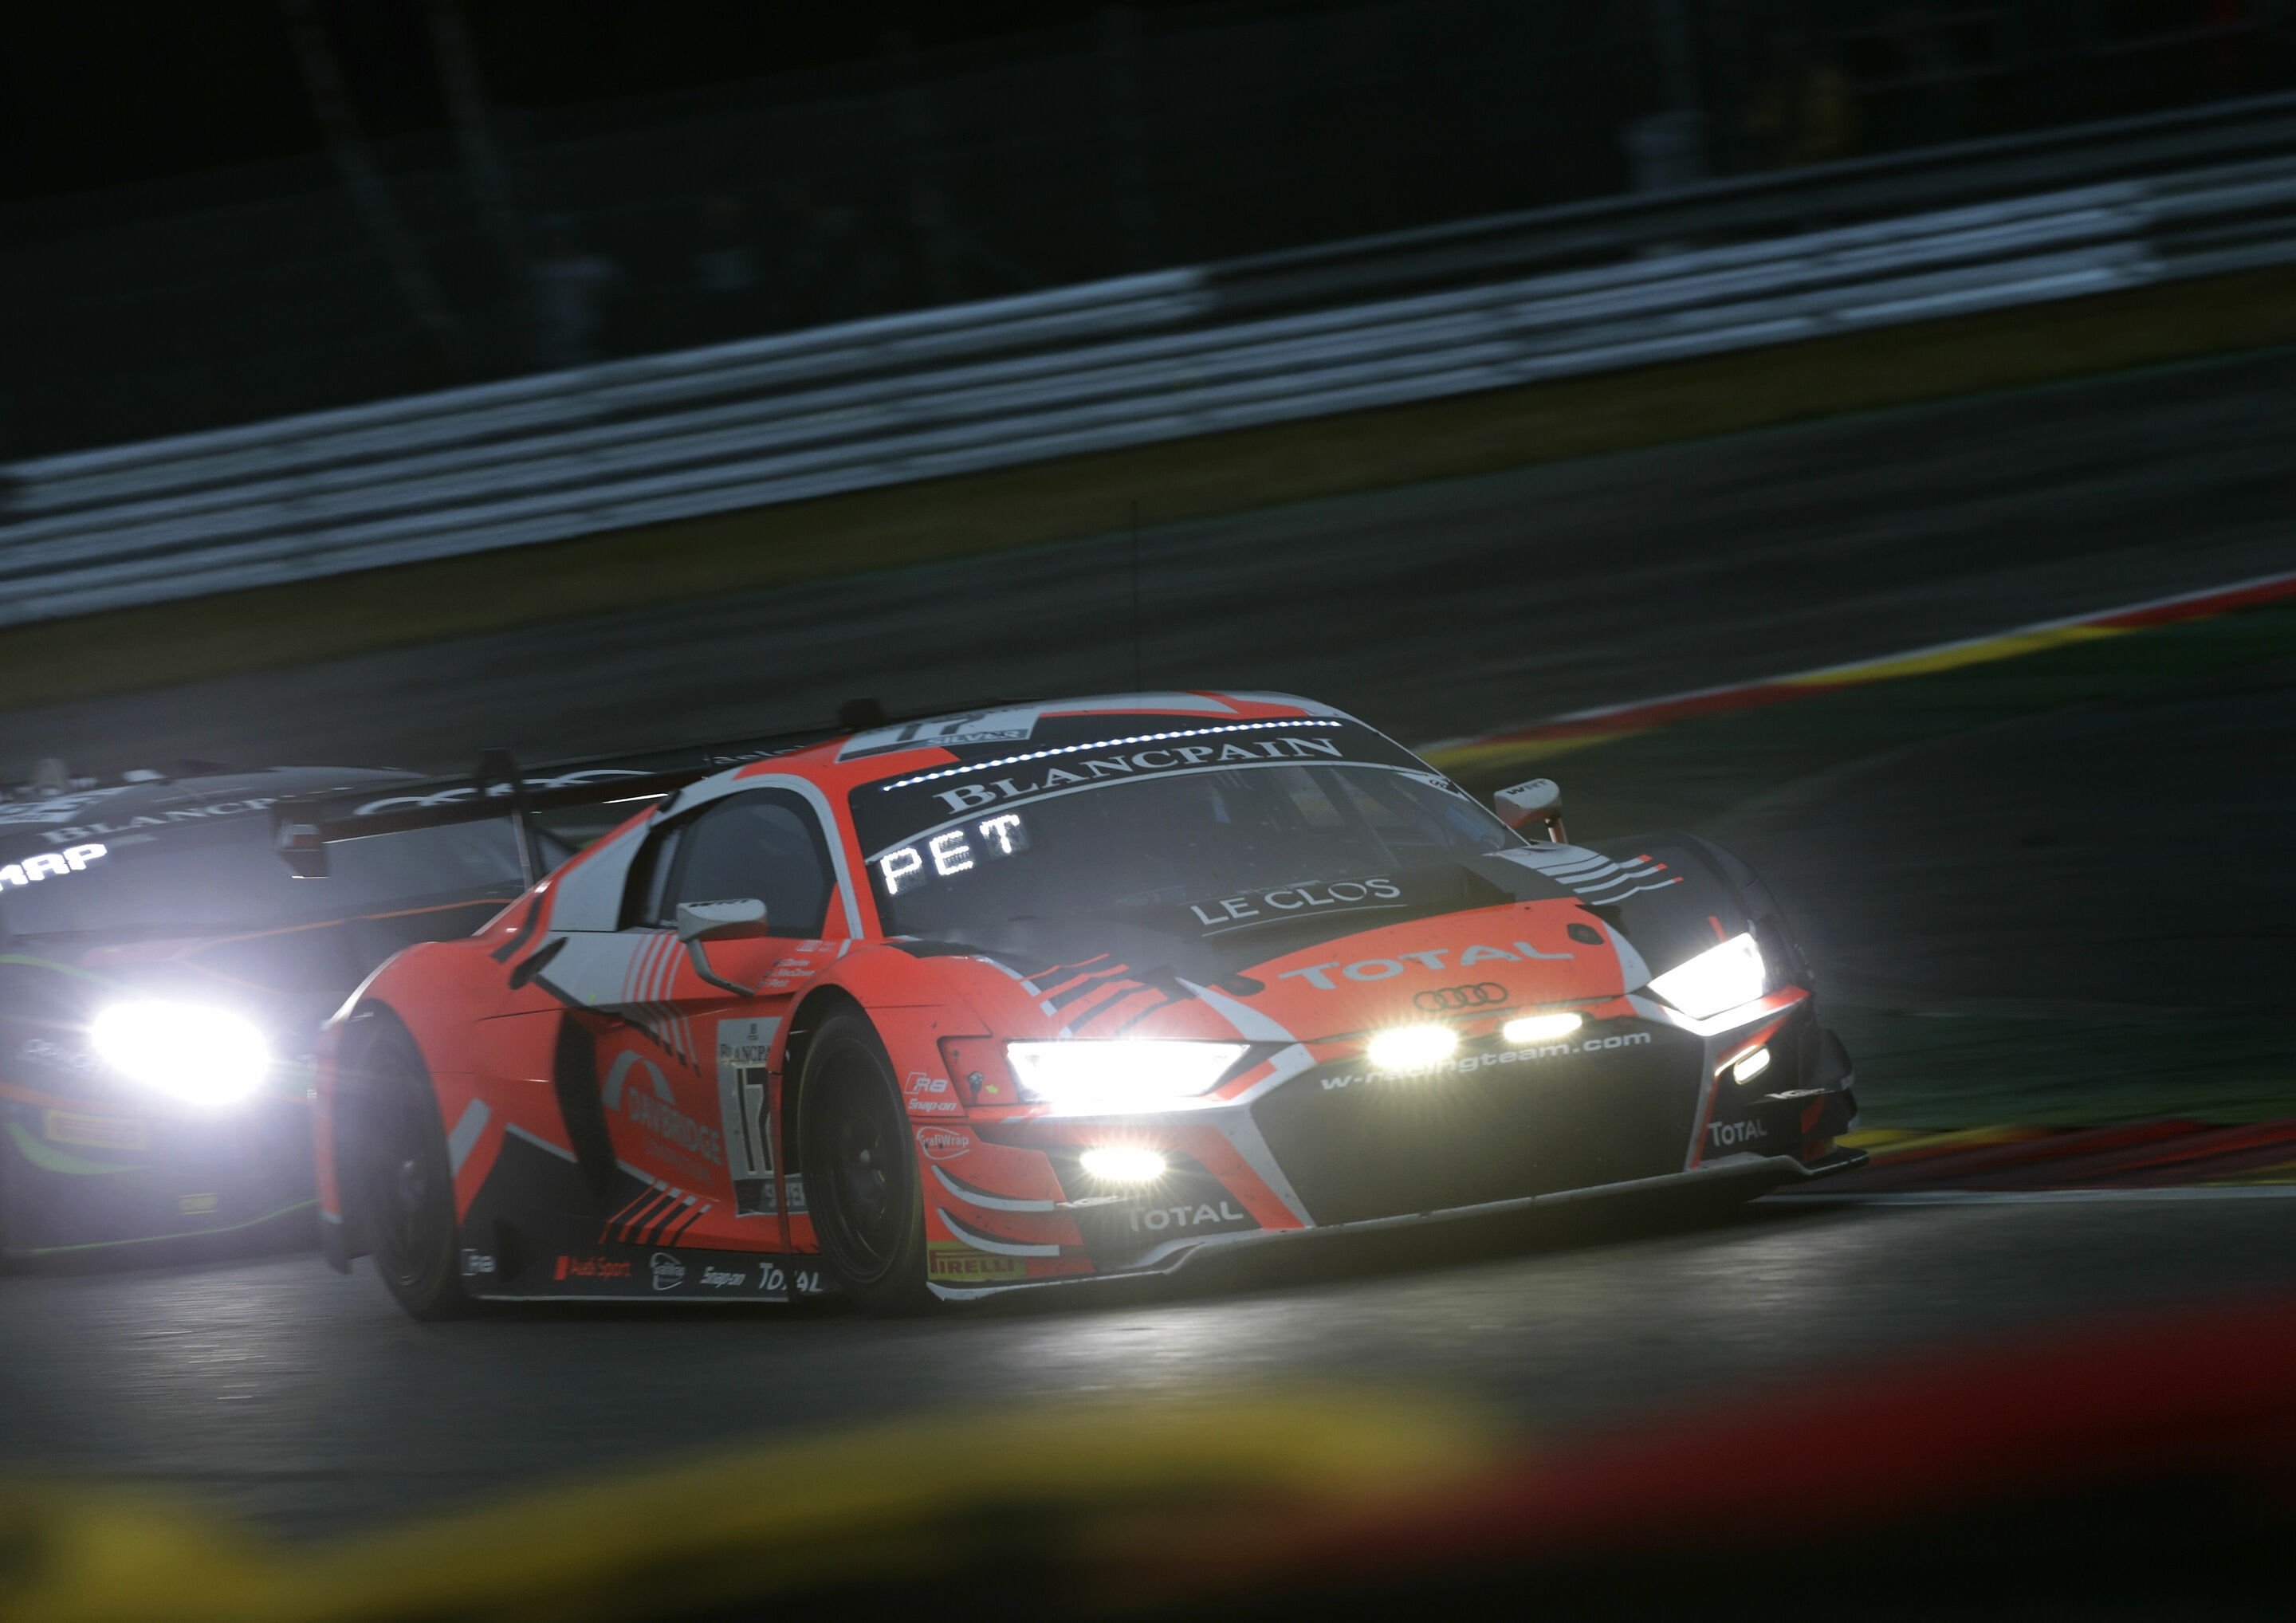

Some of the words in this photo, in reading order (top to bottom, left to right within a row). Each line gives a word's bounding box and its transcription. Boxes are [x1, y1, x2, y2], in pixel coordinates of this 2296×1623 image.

[926, 729, 1022, 748] SILVER
[933, 737, 1343, 814] BLANCPAIN
[879, 813, 1020, 895] PET
[1189, 896, 1260, 926] LE
[1264, 877, 1402, 910] CLOS
[1278, 941, 1575, 990] TOTAL
[1320, 1031, 1653, 1091] w-racingteam.com
[908, 1098, 957, 1112] Snap-on
[919, 1134, 969, 1149] GrafiWrap
[1708, 1117, 1769, 1147] TOTAL
[1128, 1201, 1244, 1232] TOTAL
[930, 1248, 1016, 1274] PIRELLI
[758, 1263, 823, 1292] TOAL
